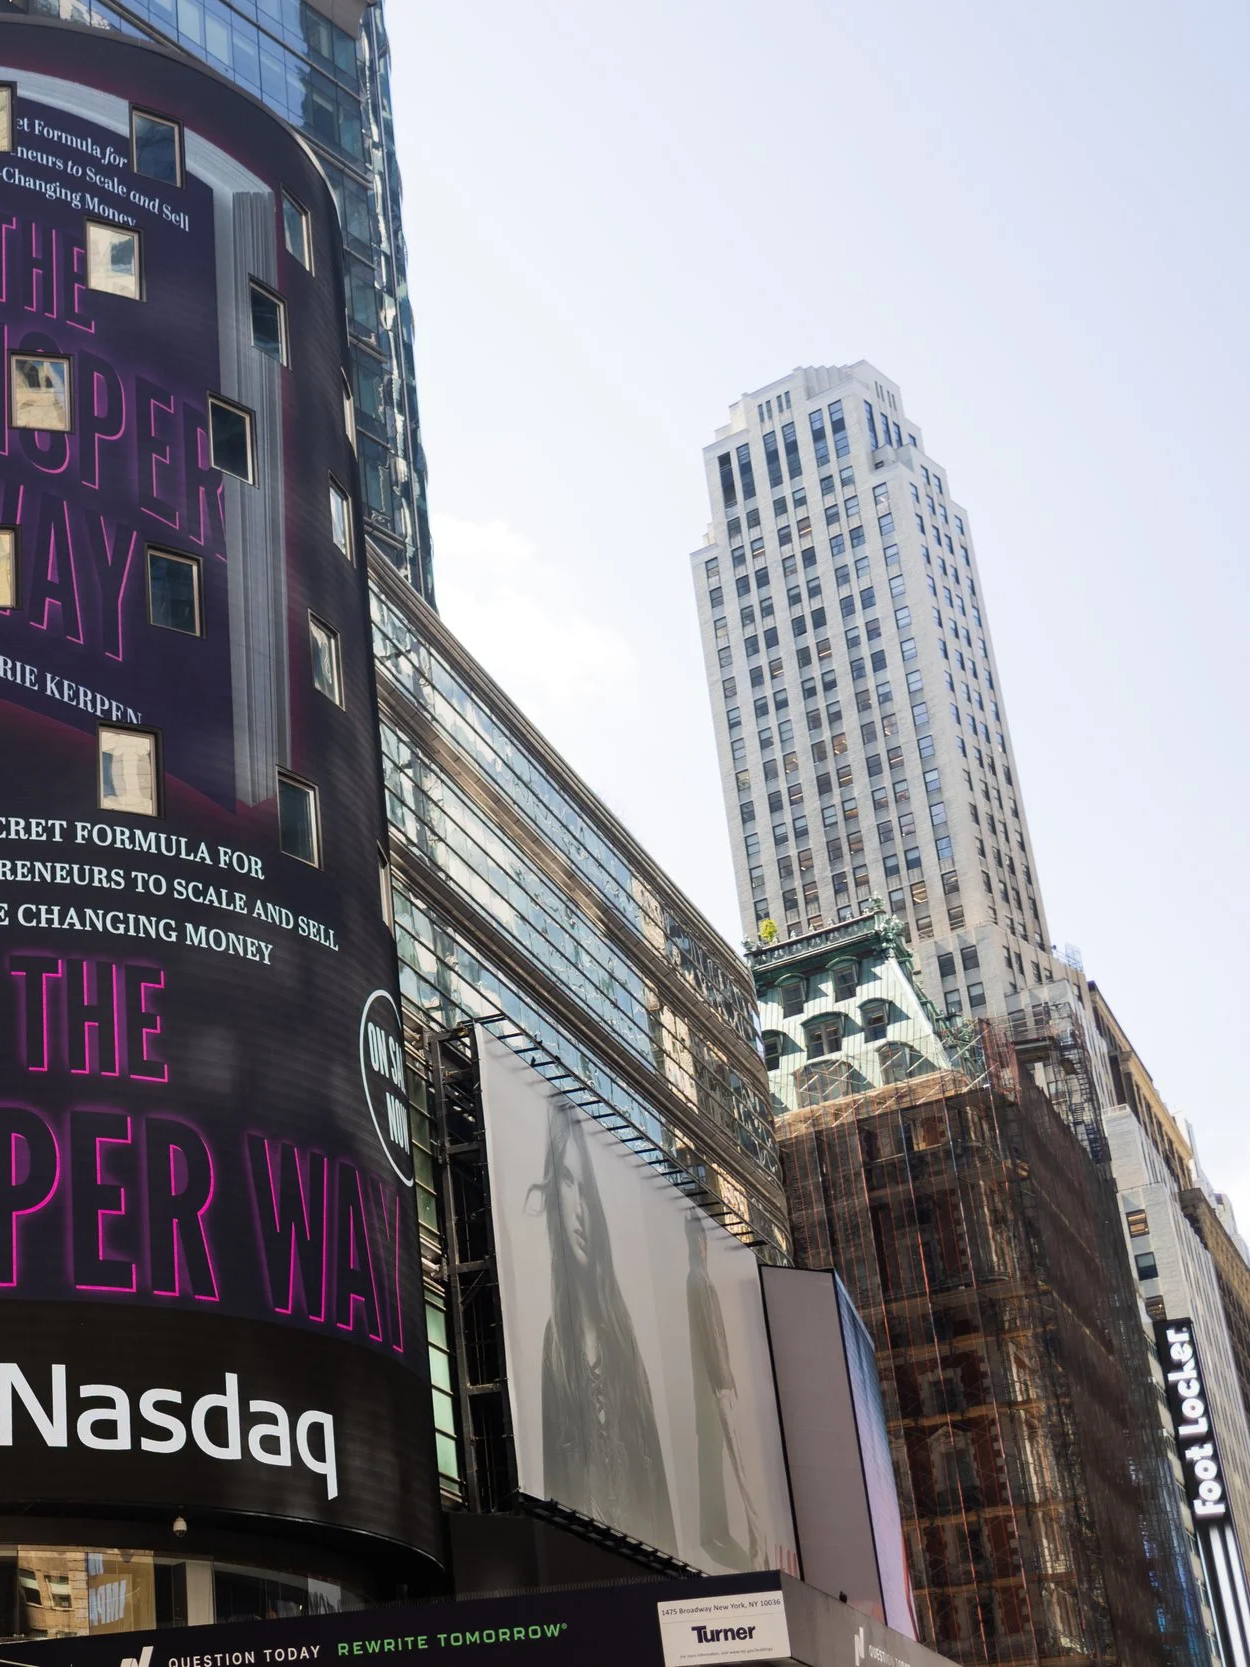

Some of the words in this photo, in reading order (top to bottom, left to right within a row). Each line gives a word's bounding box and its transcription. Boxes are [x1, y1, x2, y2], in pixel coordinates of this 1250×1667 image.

[34, 119, 101, 158] Formula
[101, 146, 128, 168] for
[67, 160, 82, 177] to
[86, 166, 127, 197] Scale
[130, 190, 160, 215] and
[162, 204, 190, 232] Sell
[45, 672, 143, 724] KERPEN
[75, 821, 213, 865] FORMULA
[218, 846, 265, 880] FOR
[17, 904, 178, 942] CHANGING
[185, 922, 273, 965] MONEY
[132, 871, 167, 896] TO
[173, 878, 248, 914] SCALE
[252, 900, 294, 930] AND
[298, 915, 339, 952] SELL
[8, 953, 170, 1084] THE
[367, 1021, 389, 1079] ON
[245, 1131, 405, 1354] WAY
[679, 1606, 712, 1615] Broadway
[760, 1599, 781, 1607] 10036
[691, 1624, 756, 1644] Turner
[168, 1651, 255, 1667] QUESTION
[263, 1645, 320, 1662] TODAY
[338, 1635, 429, 1656] REWRITE
